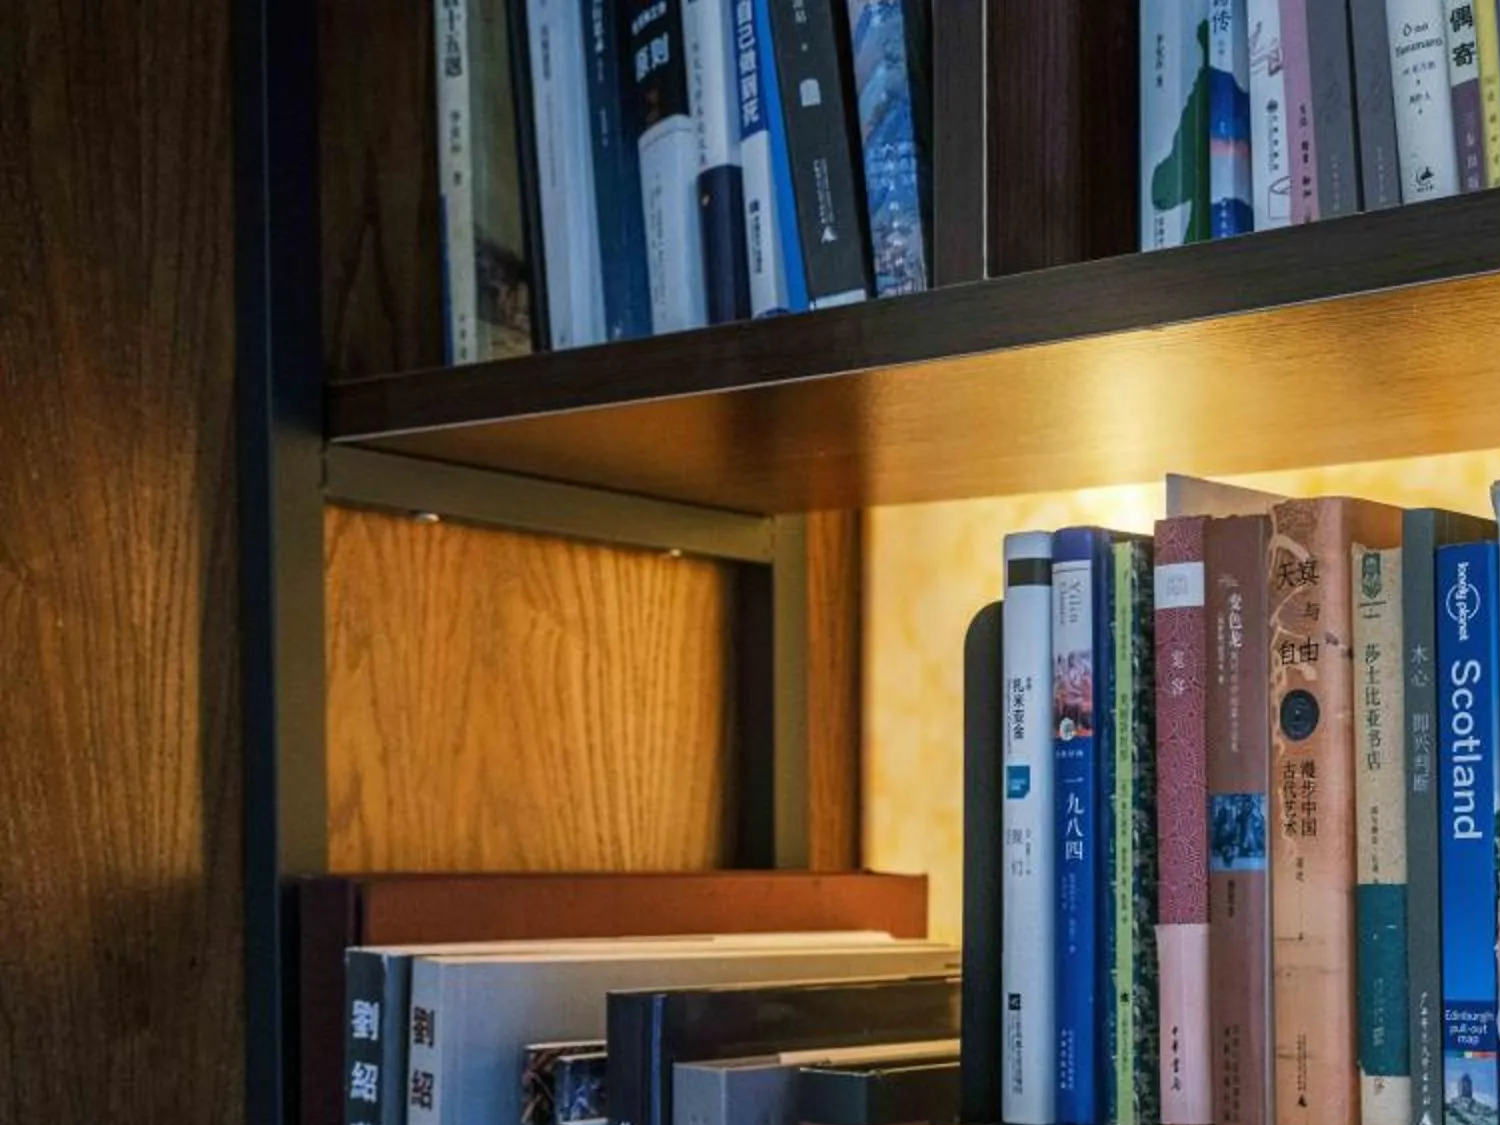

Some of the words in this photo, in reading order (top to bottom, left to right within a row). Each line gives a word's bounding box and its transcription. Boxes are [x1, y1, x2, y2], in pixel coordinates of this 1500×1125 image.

[1410, 644, 1430, 687] 木心
[1364, 643, 1382, 771] 莎士比亚书店
[1451, 659, 1483, 840] Scotland
[1063, 777, 1084, 861] 一九八四
[1445, 1009, 1494, 1026] Edinburgh
[1450, 1024, 1488, 1037] pull-out
[1457, 1034, 1480, 1047] map
